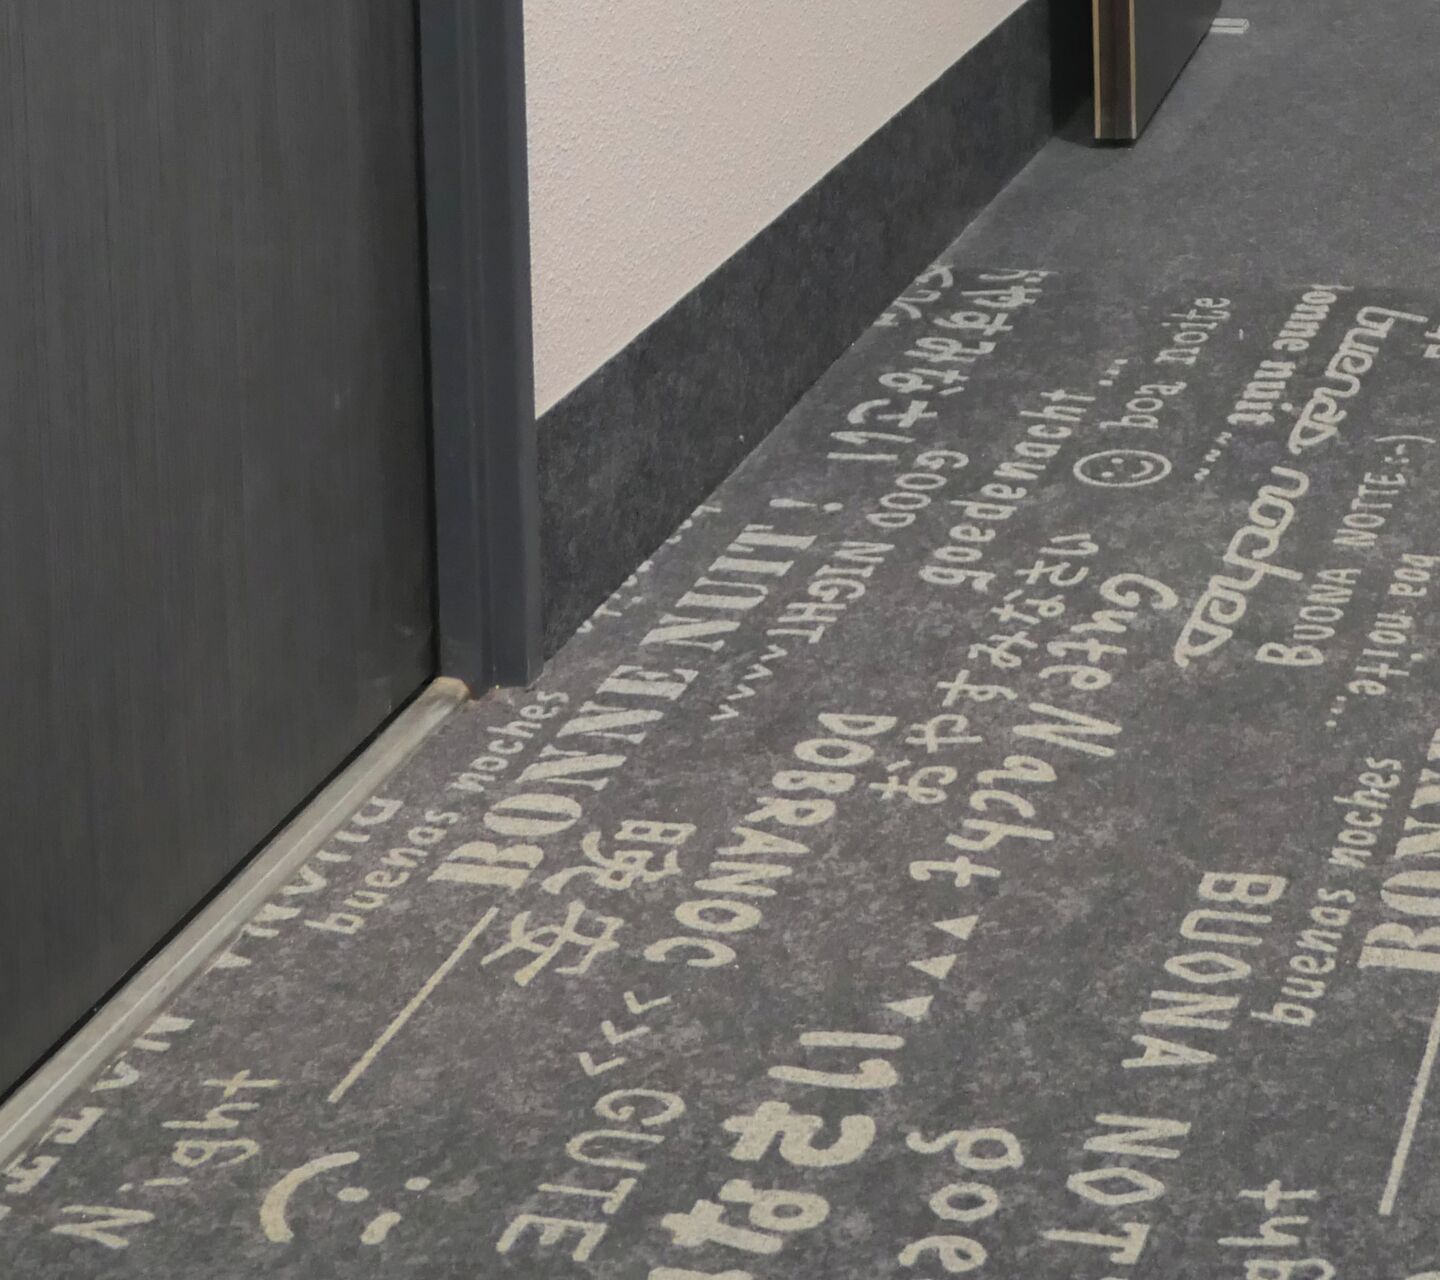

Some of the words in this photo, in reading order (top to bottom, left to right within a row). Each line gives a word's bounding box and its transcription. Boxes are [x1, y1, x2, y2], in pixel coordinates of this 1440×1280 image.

[1098, 381, 1187, 429] boa
[1153, 297, 1231, 365] noite
[1226, 359, 1296, 425] nuit
[1286, 305, 1428, 455] buenas
[865, 448, 969, 528] GOOD
[1172, 465, 1310, 671] noches
[1253, 568, 1361, 666] BUONA
[1332, 472, 1406, 549] NOTTE
[766, 540, 894, 643] NIGHT
[1037, 571, 1178, 690] Gute
[427, 664, 699, 891] BONNE
[639, 523, 816, 650] NUIT
[908, 702, 1122, 887] Nacht
[305, 809, 458, 934] buenas
[450, 690, 569, 791] noches
[642, 712, 897, 968] DOBRANOC
[1249, 887, 1355, 1026] buenas
[1327, 756, 1402, 869] noches
[1121, 871, 1287, 1068] BUONA
[49, 1069, 281, 1249] Night
[495, 1087, 686, 1262] GUTE
